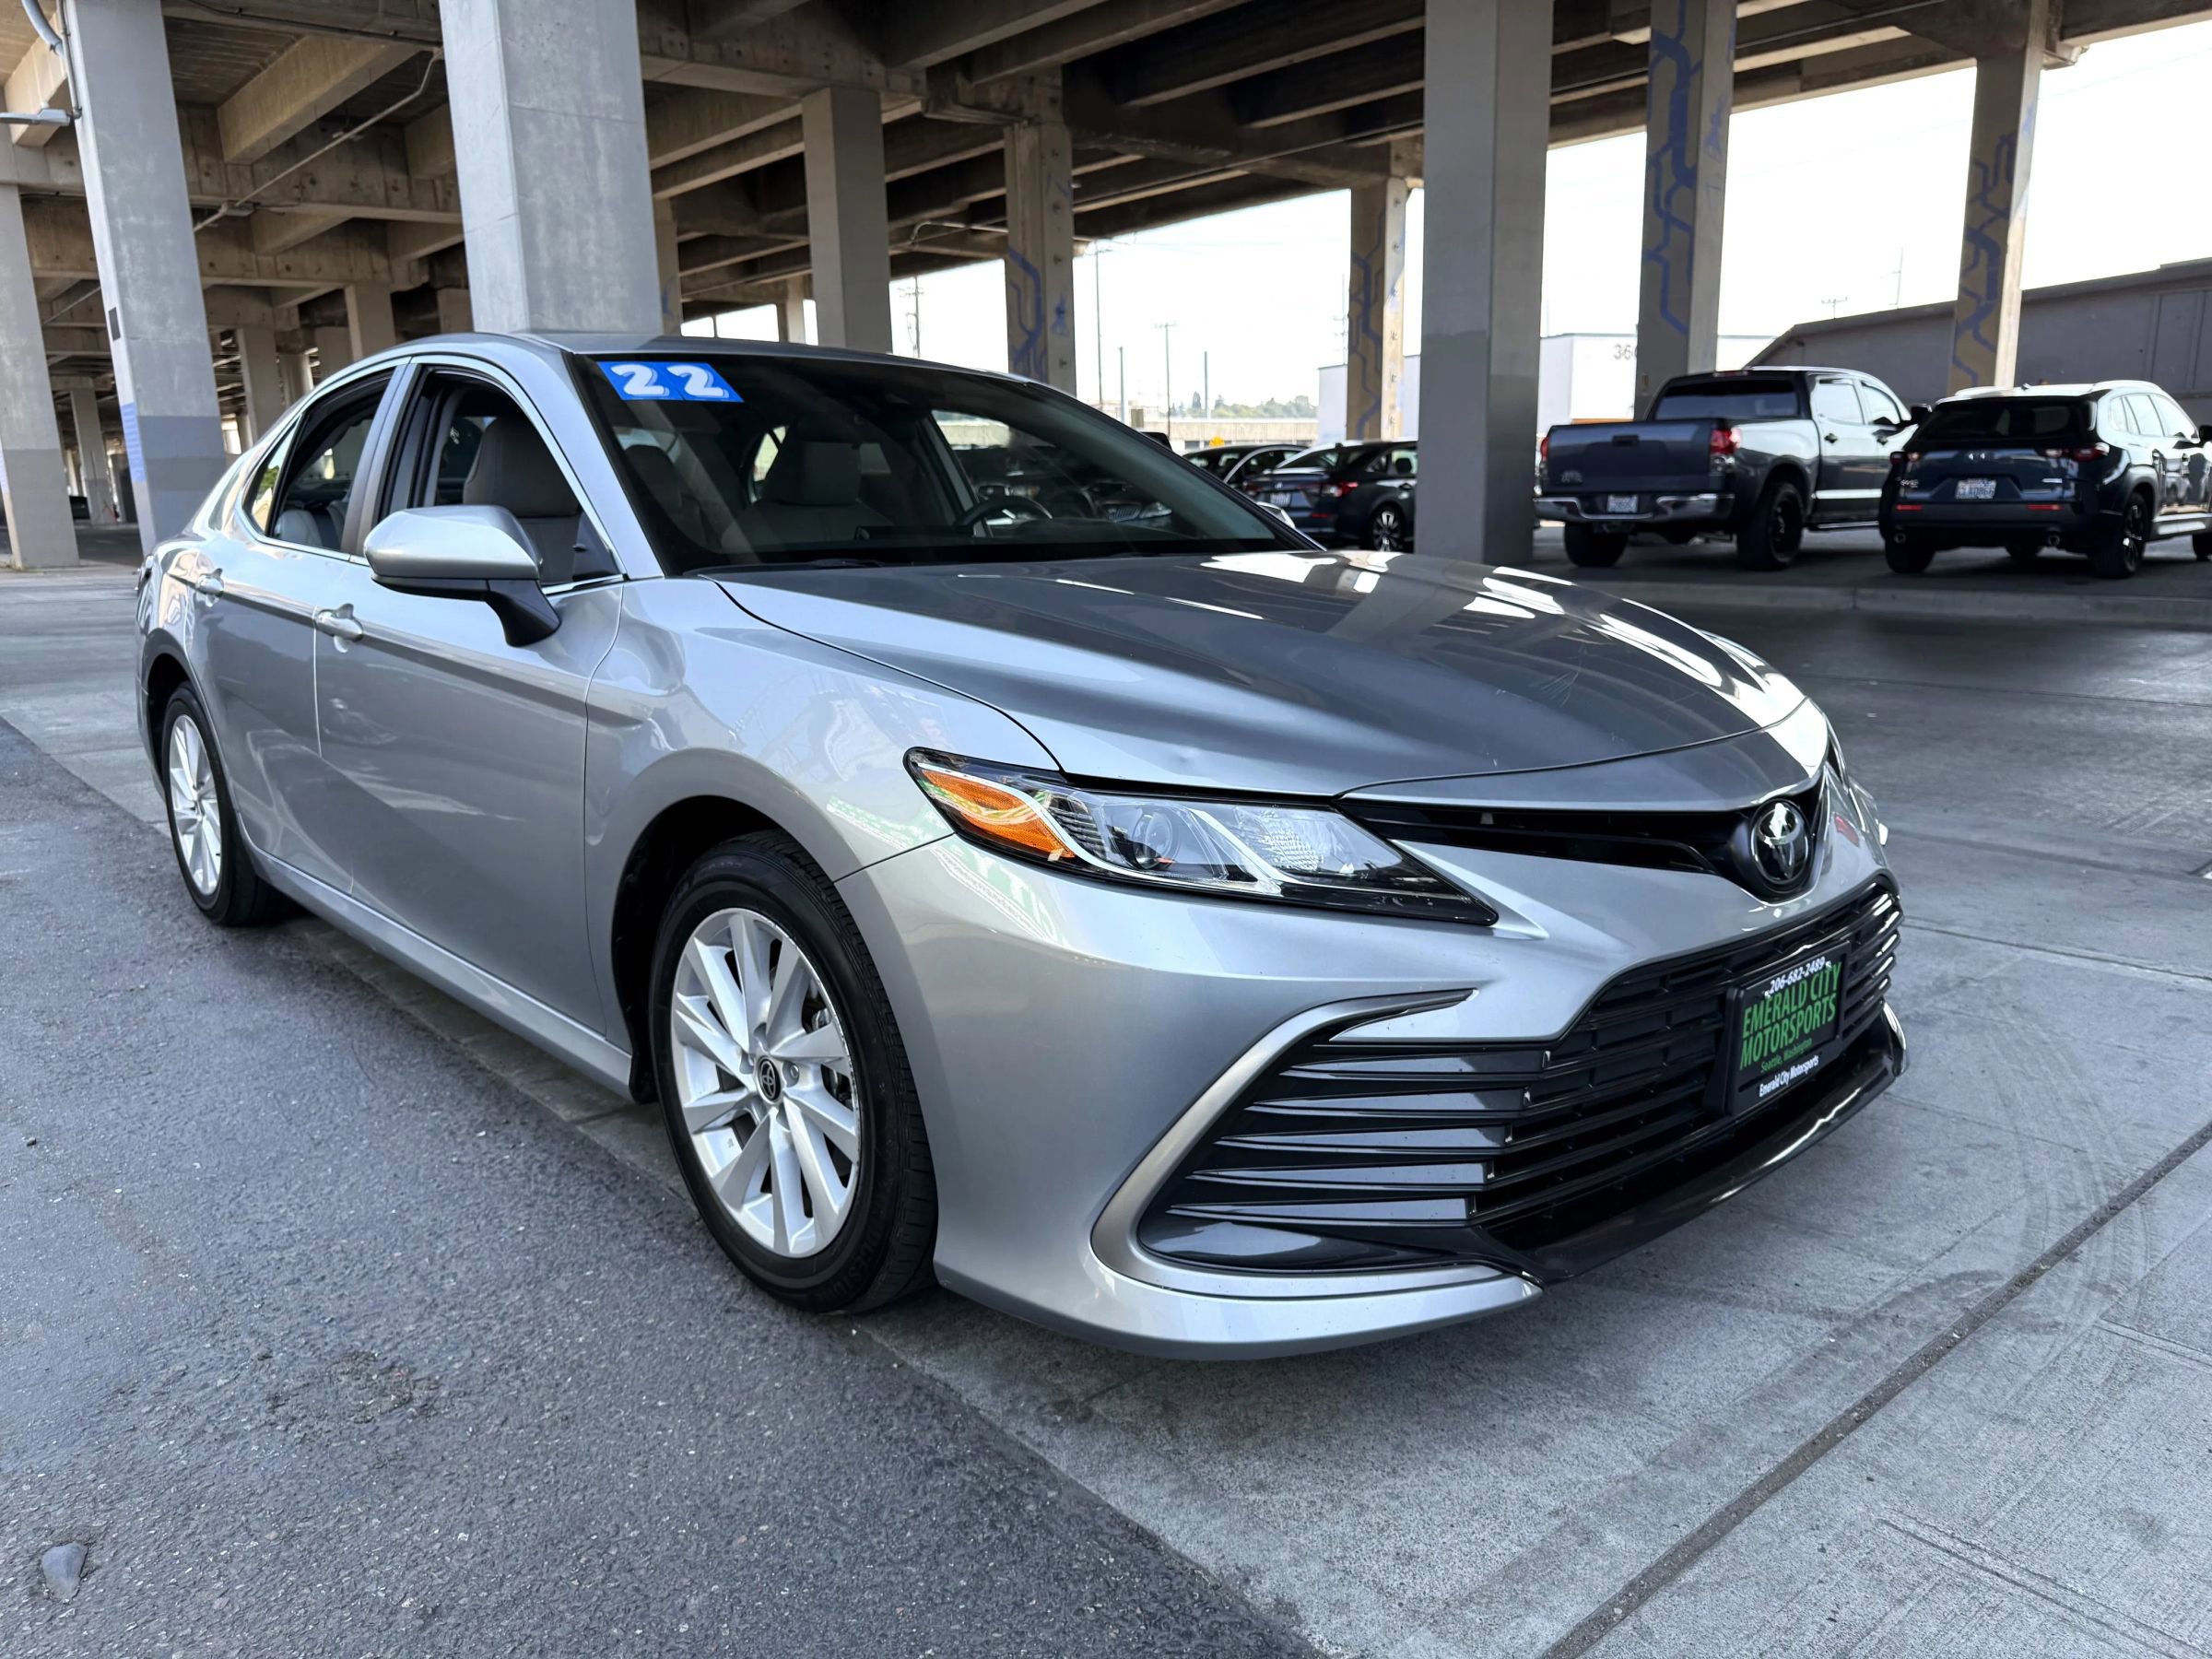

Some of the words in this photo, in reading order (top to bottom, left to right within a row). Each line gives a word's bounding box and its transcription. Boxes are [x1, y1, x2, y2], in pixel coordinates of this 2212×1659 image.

[610, 364, 729, 398] 22
[1770, 956, 1826, 994] 206-682-2489
[1743, 980, 1807, 1039] EMERALD
[1810, 961, 1842, 999] CITY
[1740, 993, 1837, 1071] MOTORSPORTS
[1759, 1073, 1781, 1098] Emerald
[1780, 1070, 1790, 1086] City
[1789, 1054, 1819, 1080] Motorsports
